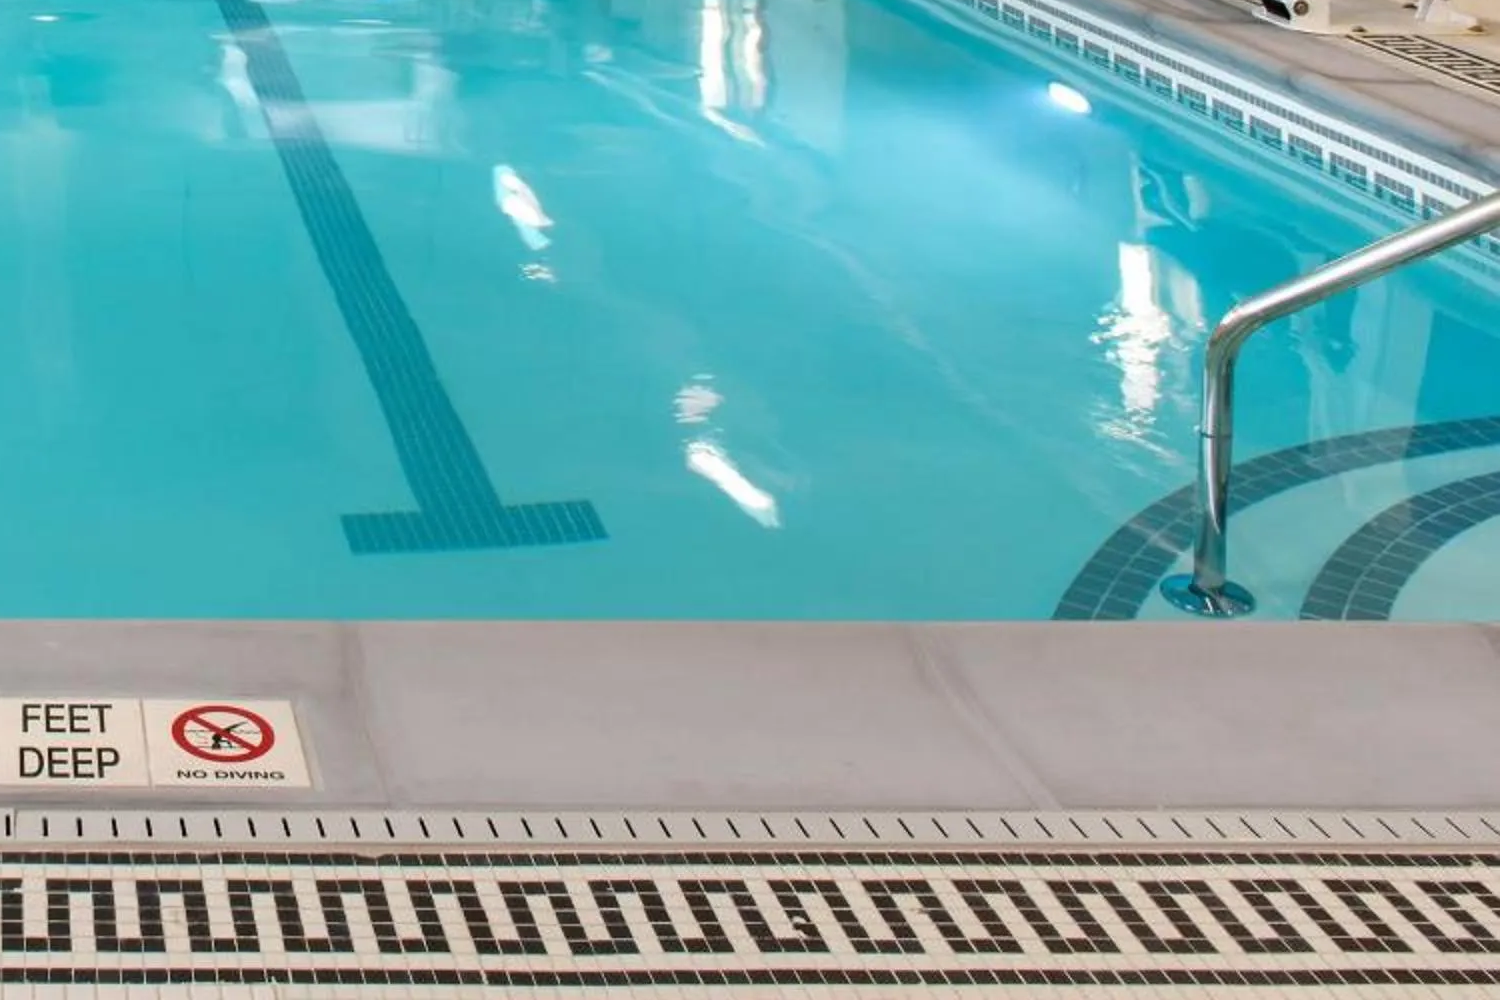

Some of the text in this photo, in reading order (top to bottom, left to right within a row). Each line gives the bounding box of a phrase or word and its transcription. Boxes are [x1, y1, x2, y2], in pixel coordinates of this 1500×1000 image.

[22, 704, 113, 733] FEET
[19, 746, 120, 779] DEEP
[177, 769, 285, 780] NO DIVING
